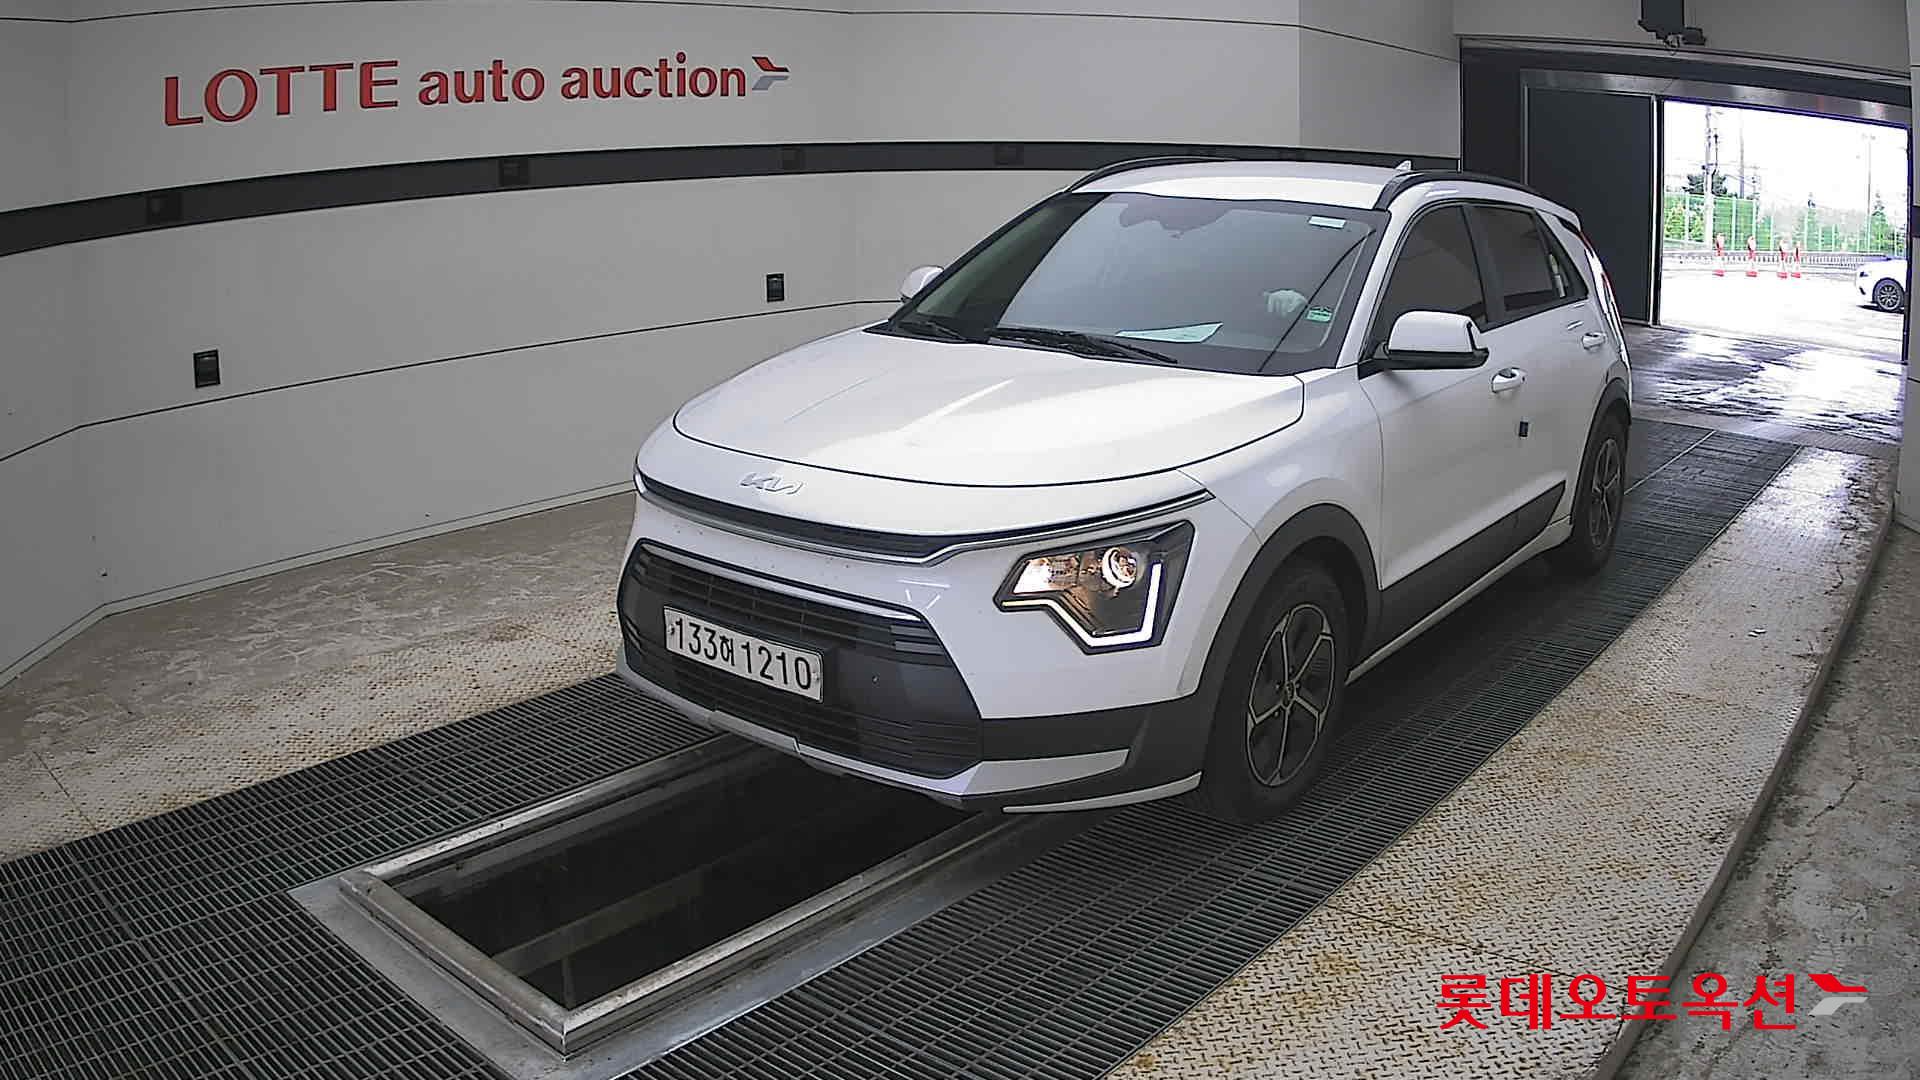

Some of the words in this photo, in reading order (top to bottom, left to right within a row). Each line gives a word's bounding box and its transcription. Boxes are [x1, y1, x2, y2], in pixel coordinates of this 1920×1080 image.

[164, 60, 399, 126] LOTTE
[418, 59, 546, 105] auto
[561, 52, 746, 98] auction
